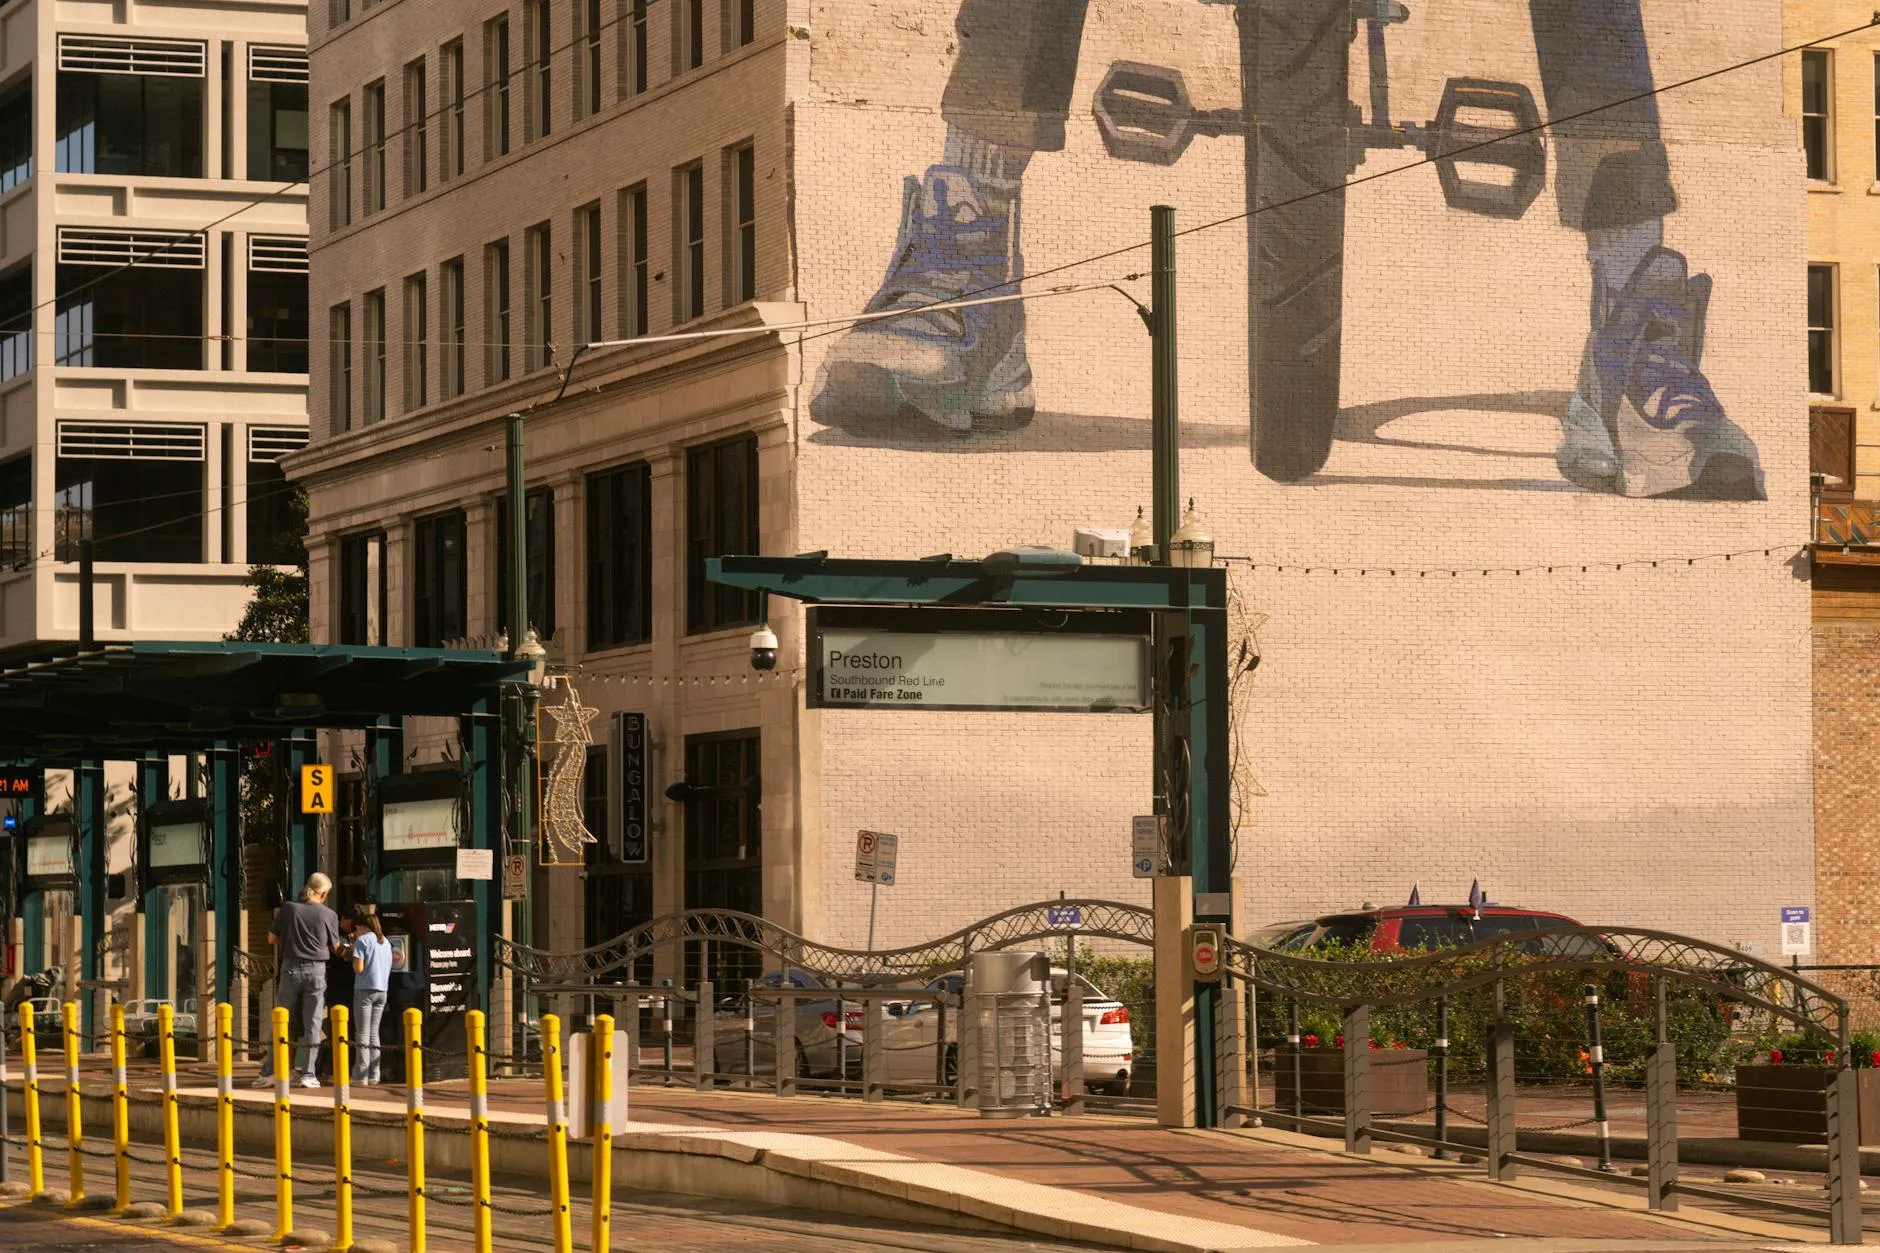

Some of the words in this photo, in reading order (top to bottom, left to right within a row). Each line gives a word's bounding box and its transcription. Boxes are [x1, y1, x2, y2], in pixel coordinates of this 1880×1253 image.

[830, 651, 902, 669] Preston
[830, 674, 895, 685] Southbound
[899, 675, 919, 686] Red
[923, 676, 945, 686] Line
[844, 688, 867, 699] Paid
[870, 689, 894, 699] Fare
[897, 689, 923, 700] Zone
[12, 779, 29, 791] AM
[626, 716, 642, 857] BUNGALOW
[429, 948, 453, 958] Welcome
